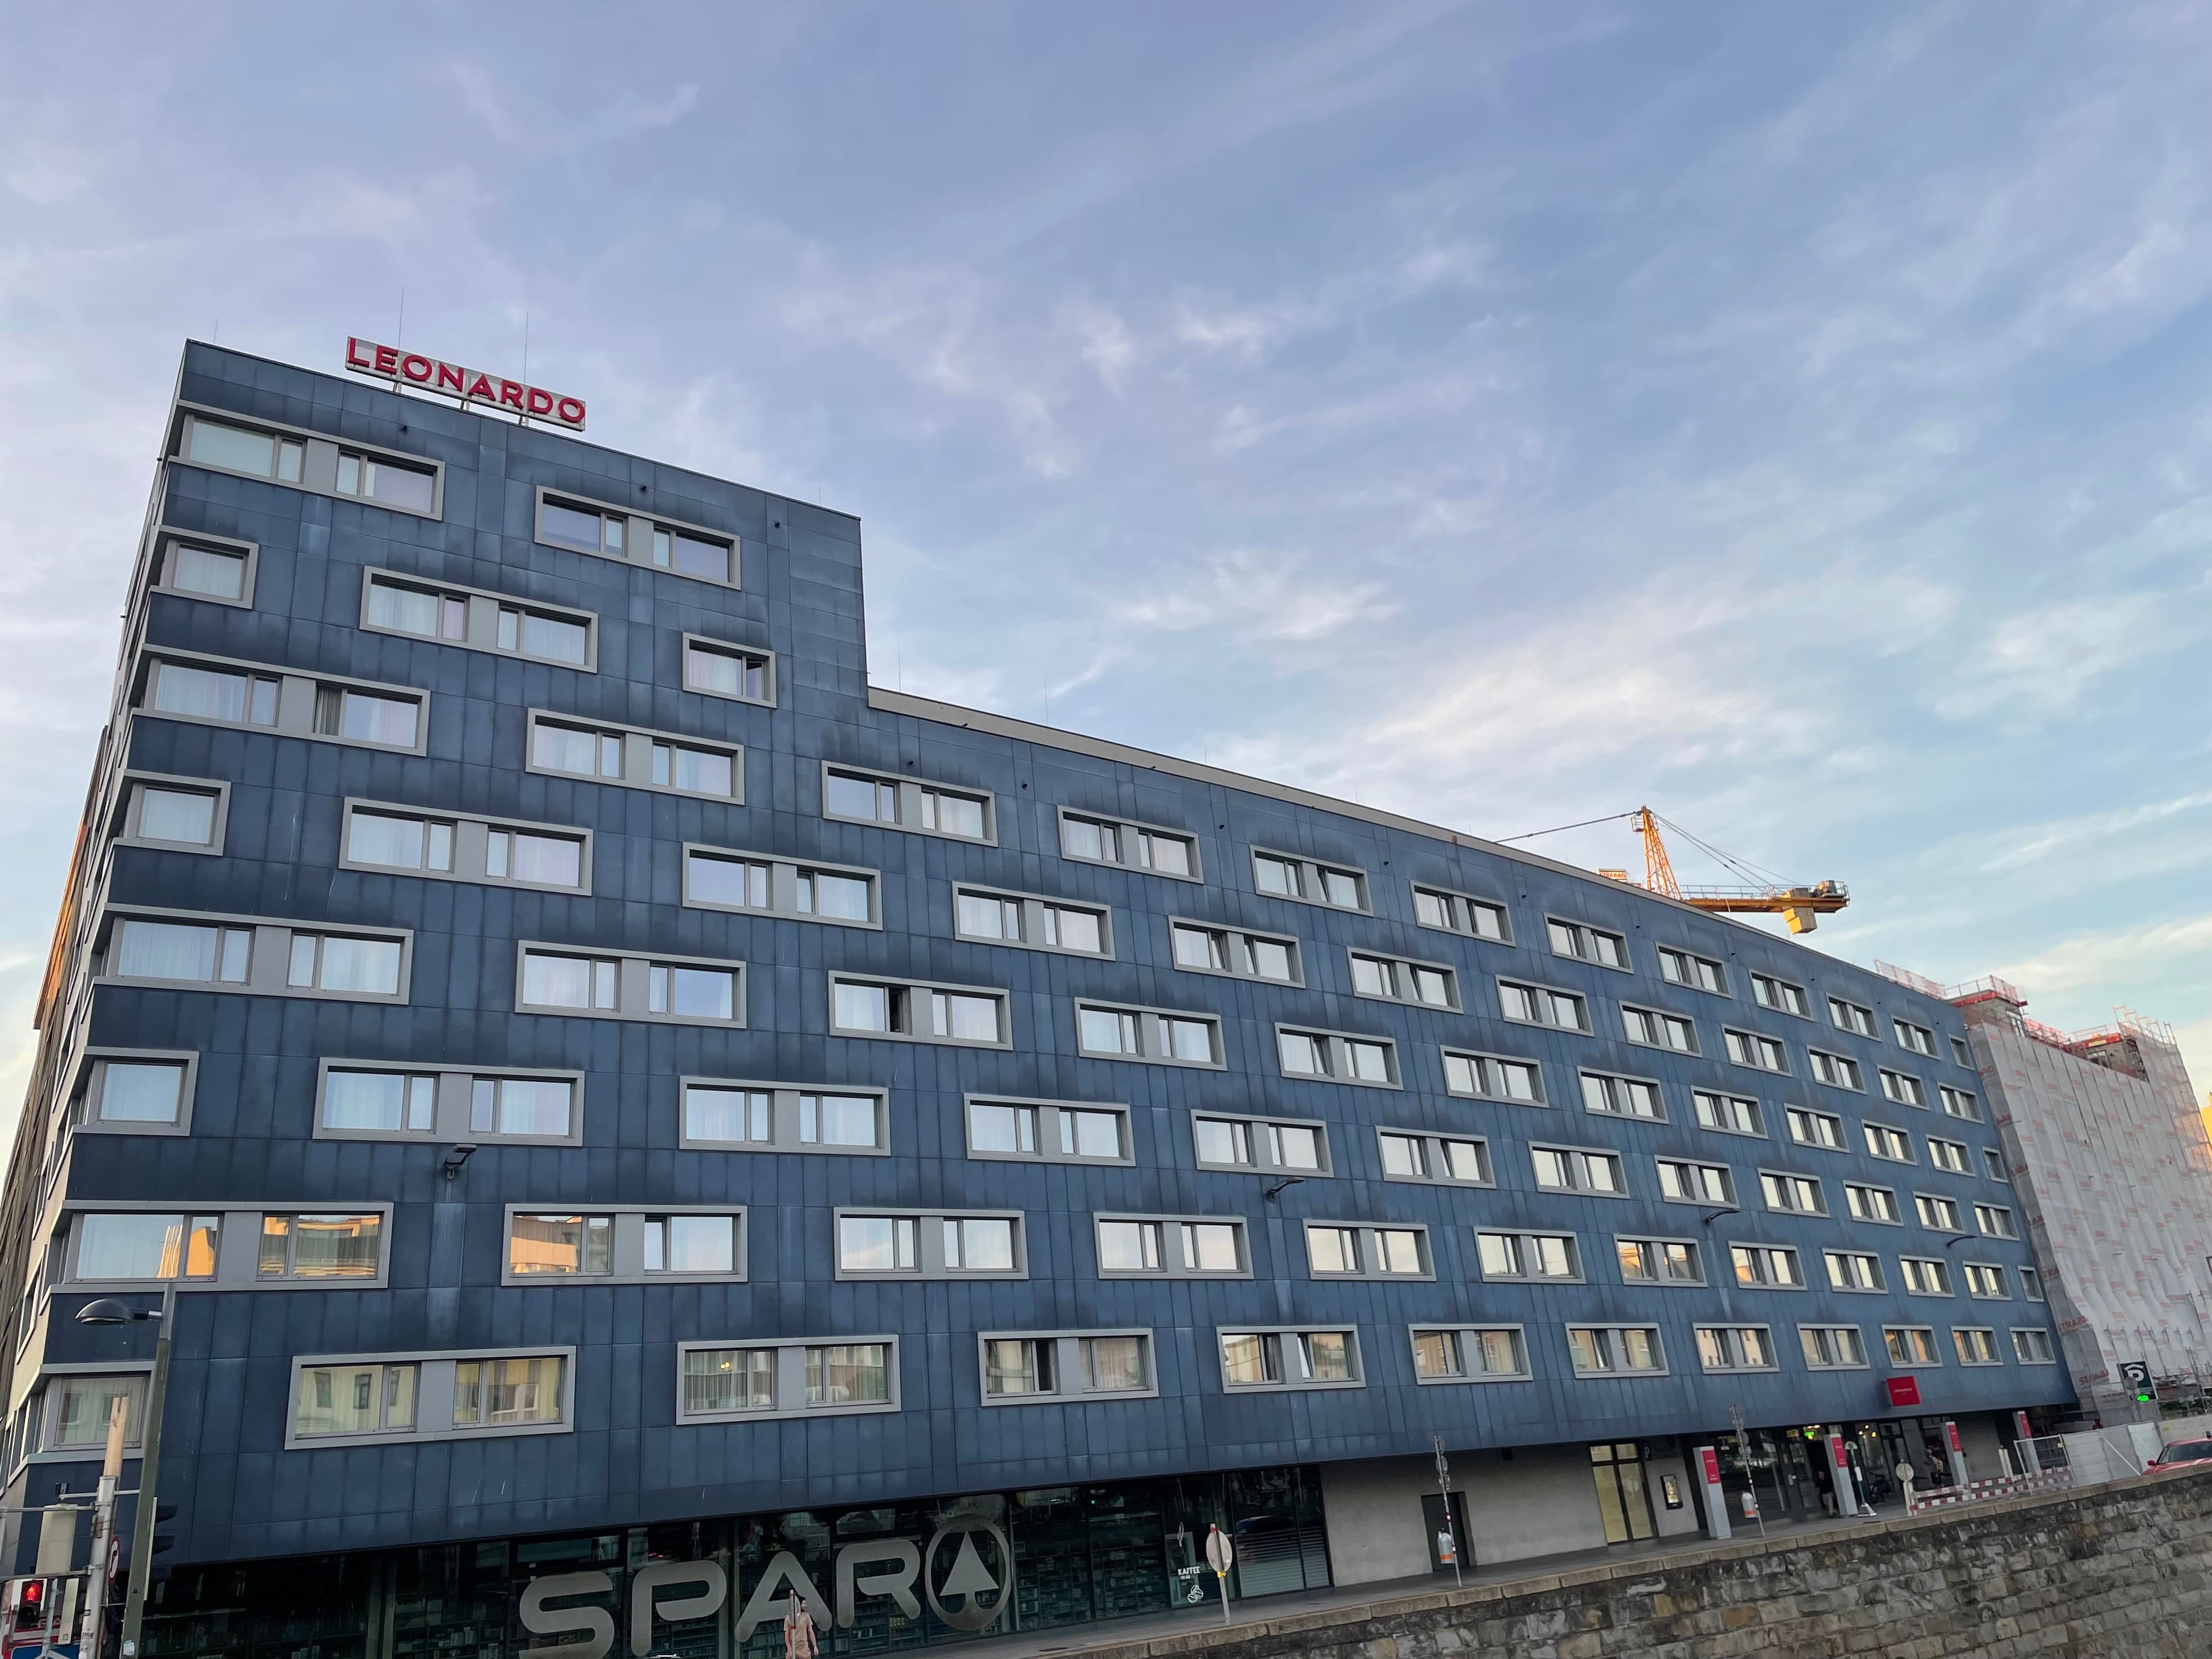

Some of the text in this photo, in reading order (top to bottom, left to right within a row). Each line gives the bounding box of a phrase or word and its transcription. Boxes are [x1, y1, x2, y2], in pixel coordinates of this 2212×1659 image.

[347, 338, 585, 424] LEONARDO
[519, 1537, 921, 1659] SPAR
[1177, 1566, 1200, 1576] KAFFEE
